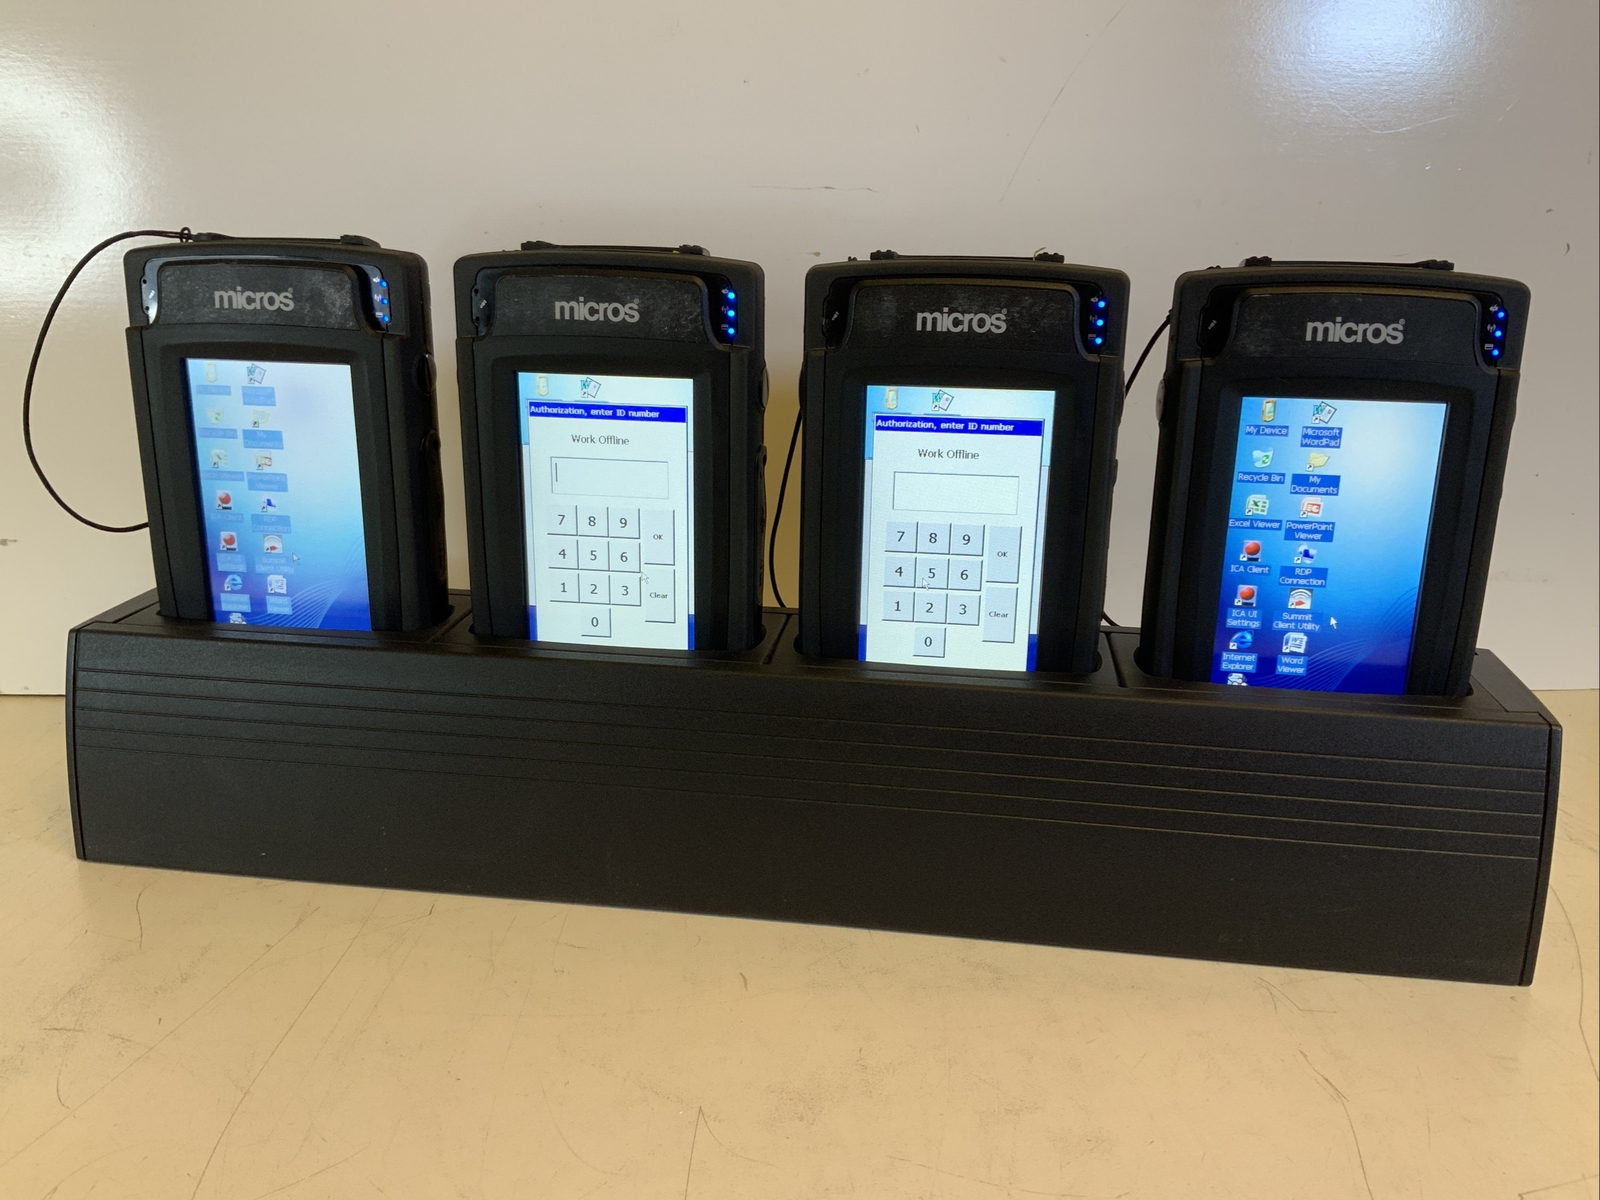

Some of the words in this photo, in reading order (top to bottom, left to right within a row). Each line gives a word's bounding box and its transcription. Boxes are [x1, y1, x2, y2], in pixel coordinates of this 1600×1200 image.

[530, 405, 588, 416] Authorization,
[590, 408, 613, 416] enter
[616, 409, 626, 417] ID
[628, 410, 660, 418] number
[876, 419, 937, 430] Authorization,
[940, 422, 965, 430] enter
[968, 423, 978, 431] ID
[980, 423, 1015, 432] number
[1245, 426, 1258, 434] My
[1260, 426, 1288, 435] Device
[1302, 428, 1340, 436] Microsoft
[571, 434, 596, 444] Work
[598, 435, 630, 446] Offline
[1302, 438, 1340, 447] WordPad
[918, 448, 944, 458] Work
[946, 449, 980, 460] Offline
[1238, 473, 1269, 482] Recycle
[1271, 474, 1284, 482] Bin
[1309, 476, 1321, 484] My
[1291, 485, 1338, 494] Documents
[557, 514, 565, 525] 7
[588, 516, 596, 527] 8
[620, 518, 627, 528] 9
[1229, 519, 1251, 527] Excel
[1252, 520, 1281, 529] Viewer
[1286, 522, 1333, 531] PowerPoint
[897, 531, 905, 542] 7
[929, 532, 938, 543] 8
[962, 534, 971, 545] 9
[1294, 532, 1322, 540] Viewer
[558, 549, 566, 559] 4
[590, 550, 597, 561] 5
[620, 552, 628, 562] 6
[895, 566, 903, 577] 4
[928, 568, 936, 578] 5
[1247, 565, 1269, 573] Client
[960, 569, 969, 580] 6
[1280, 577, 1325, 586] Connection
[561, 582, 567, 593] 1
[590, 584, 598, 594] 2
[622, 585, 629, 596] 3
[894, 601, 901, 612] 1
[925, 602, 934, 614] 2
[959, 604, 967, 615] 3
[1248, 610, 1258, 618] UI
[1282, 612, 1312, 620] Summit
[591, 617, 599, 627] 0
[1227, 619, 1260, 628] Settings
[1273, 621, 1296, 629] Client
[1297, 622, 1320, 631] Utility
[924, 636, 932, 647] 0
[1222, 653, 1256, 661] Internet
[1222, 662, 1254, 671] Explorer
[1277, 665, 1304, 673] Viewer
